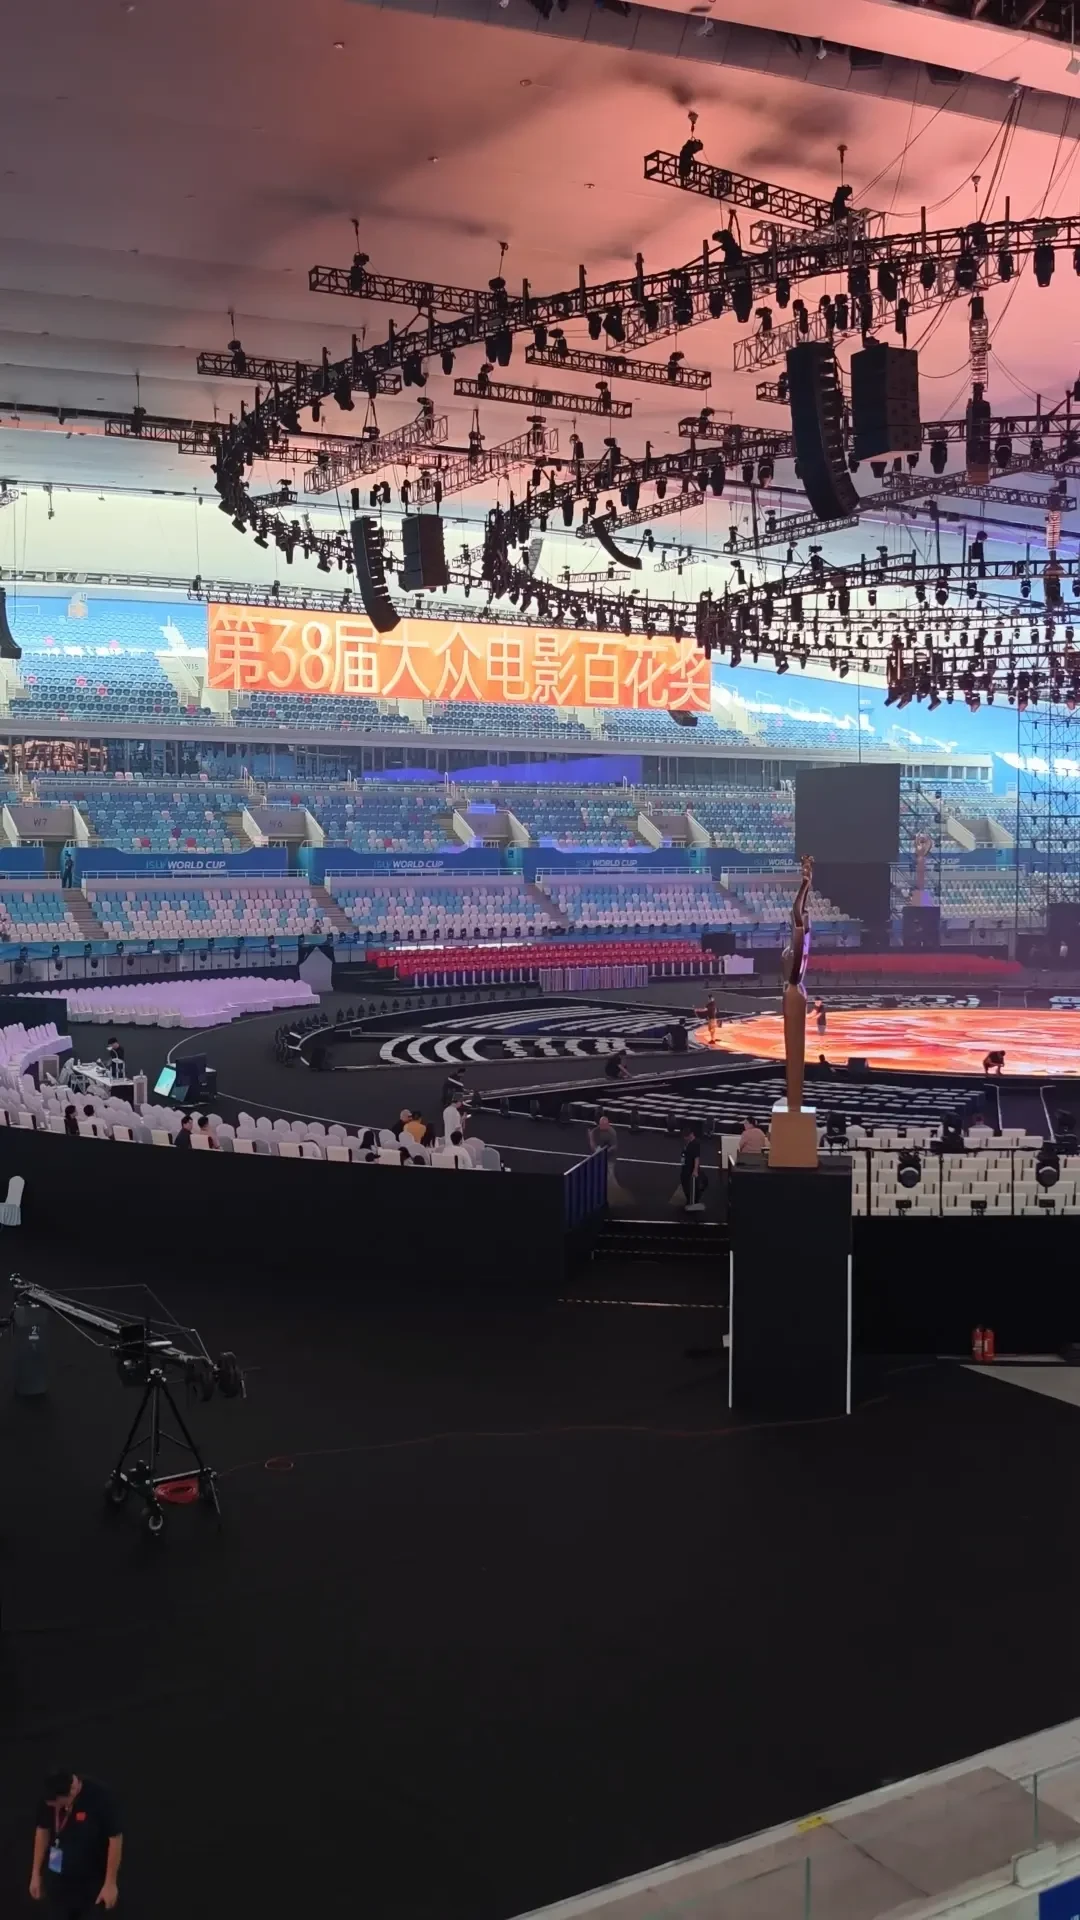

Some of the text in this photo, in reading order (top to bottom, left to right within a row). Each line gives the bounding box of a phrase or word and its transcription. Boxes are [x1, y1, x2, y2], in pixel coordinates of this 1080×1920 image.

[210, 605, 711, 710] 第38届大众电影百花奖
[168, 860, 204, 869] WORLD
[205, 860, 226, 869] CUP
[393, 860, 425, 869] WORLD
[425, 860, 444, 868] CUP
[592, 859, 620, 867] WORLD
[621, 859, 638, 867] CUP
[768, 858, 793, 866] WORLD
